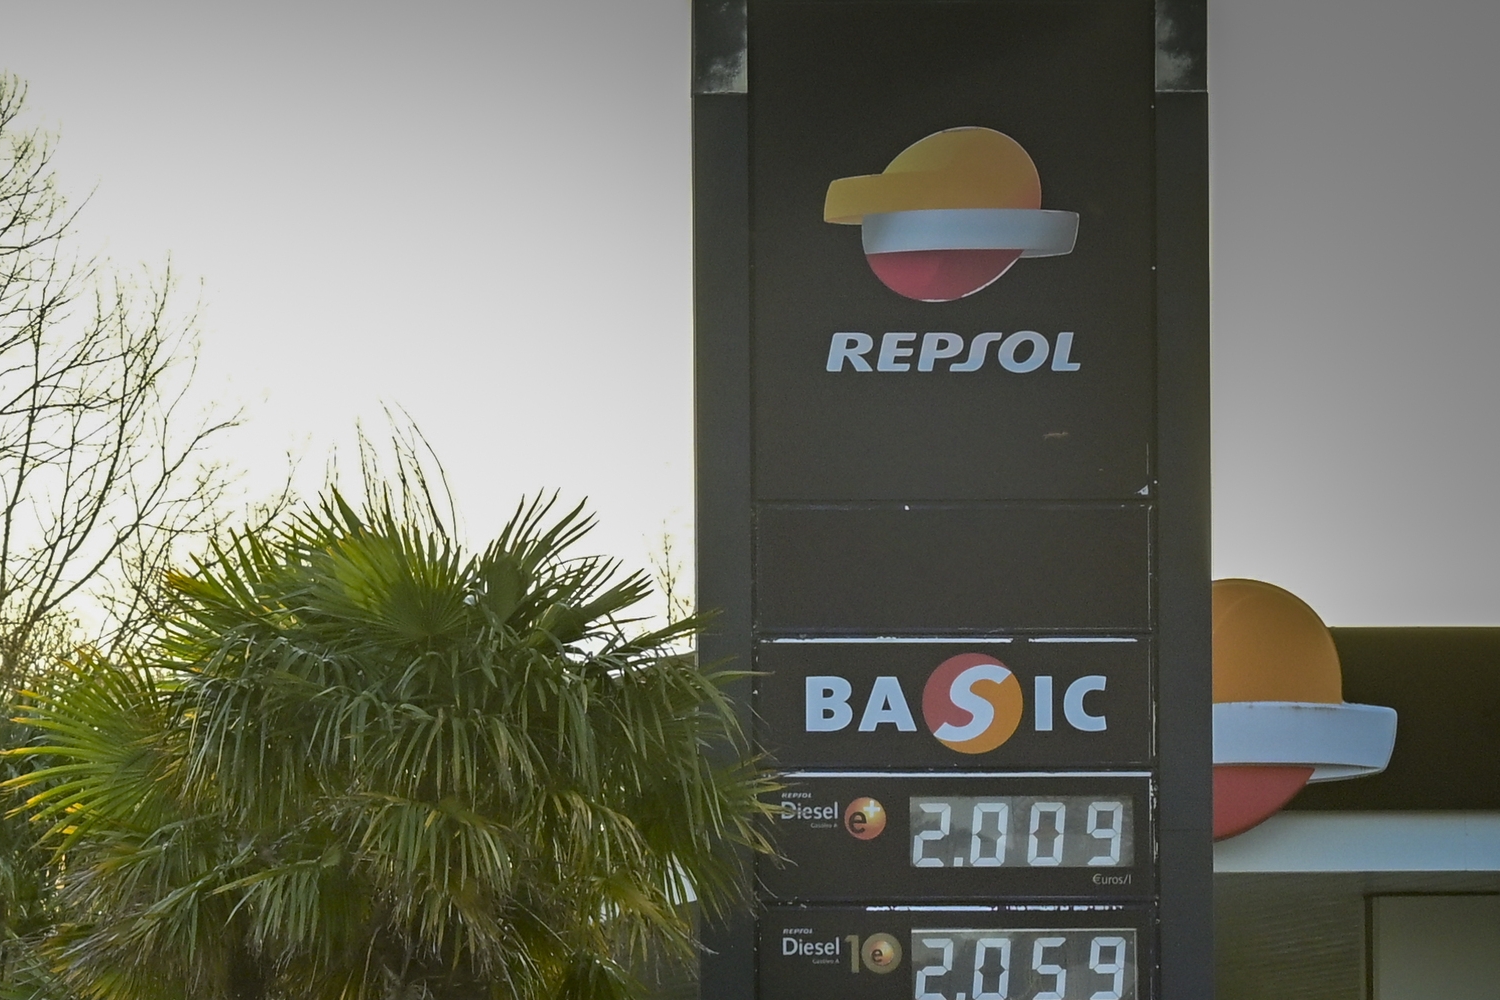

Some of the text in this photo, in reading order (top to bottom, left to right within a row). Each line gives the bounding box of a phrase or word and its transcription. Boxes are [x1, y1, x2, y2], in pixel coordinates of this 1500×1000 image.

[826, 331, 1081, 373] REPSOL
[805, 664, 1107, 742] BASIC
[781, 801, 839, 820] Diesel
[913, 802, 1123, 867] 2.009
[782, 936, 840, 956] Diesel
